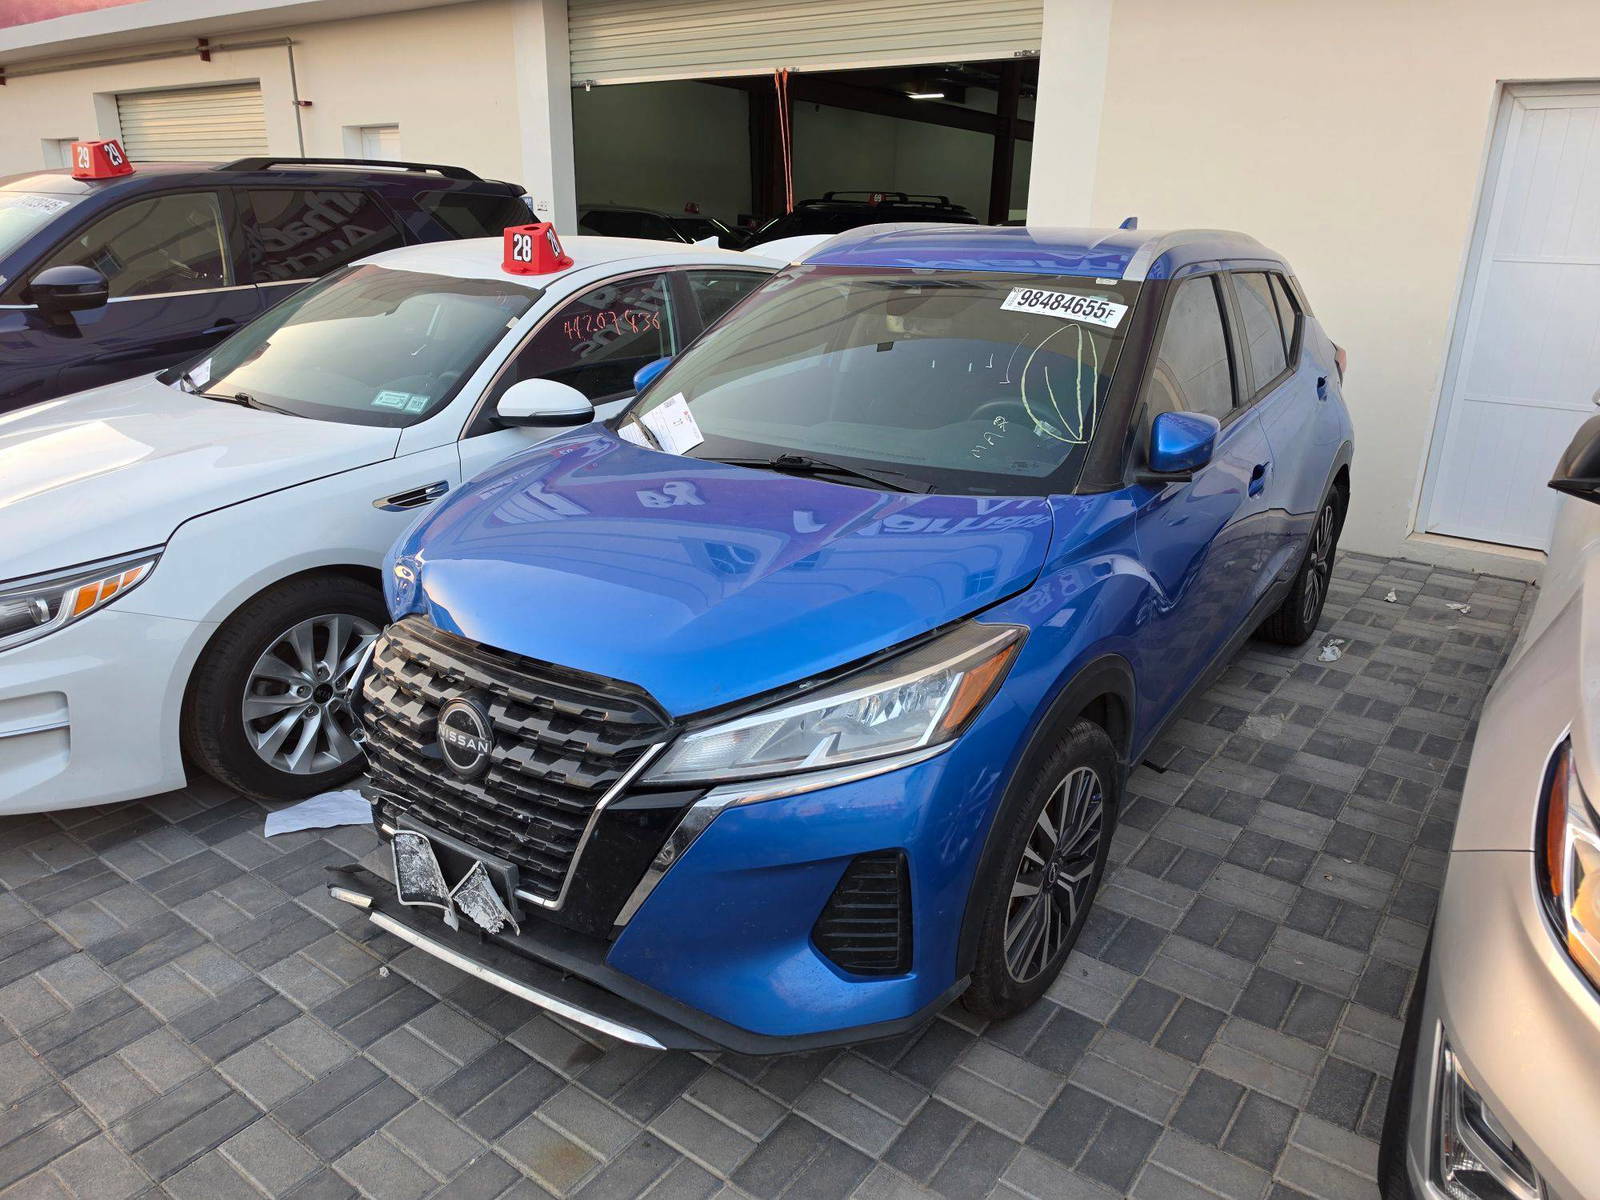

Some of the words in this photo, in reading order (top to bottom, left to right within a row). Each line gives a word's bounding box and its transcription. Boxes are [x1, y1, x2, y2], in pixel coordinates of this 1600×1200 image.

[77, 146, 90, 169] 29
[103, 143, 123, 167] 29
[513, 233, 532, 262] 28
[438, 724, 489, 752] NISSAN
